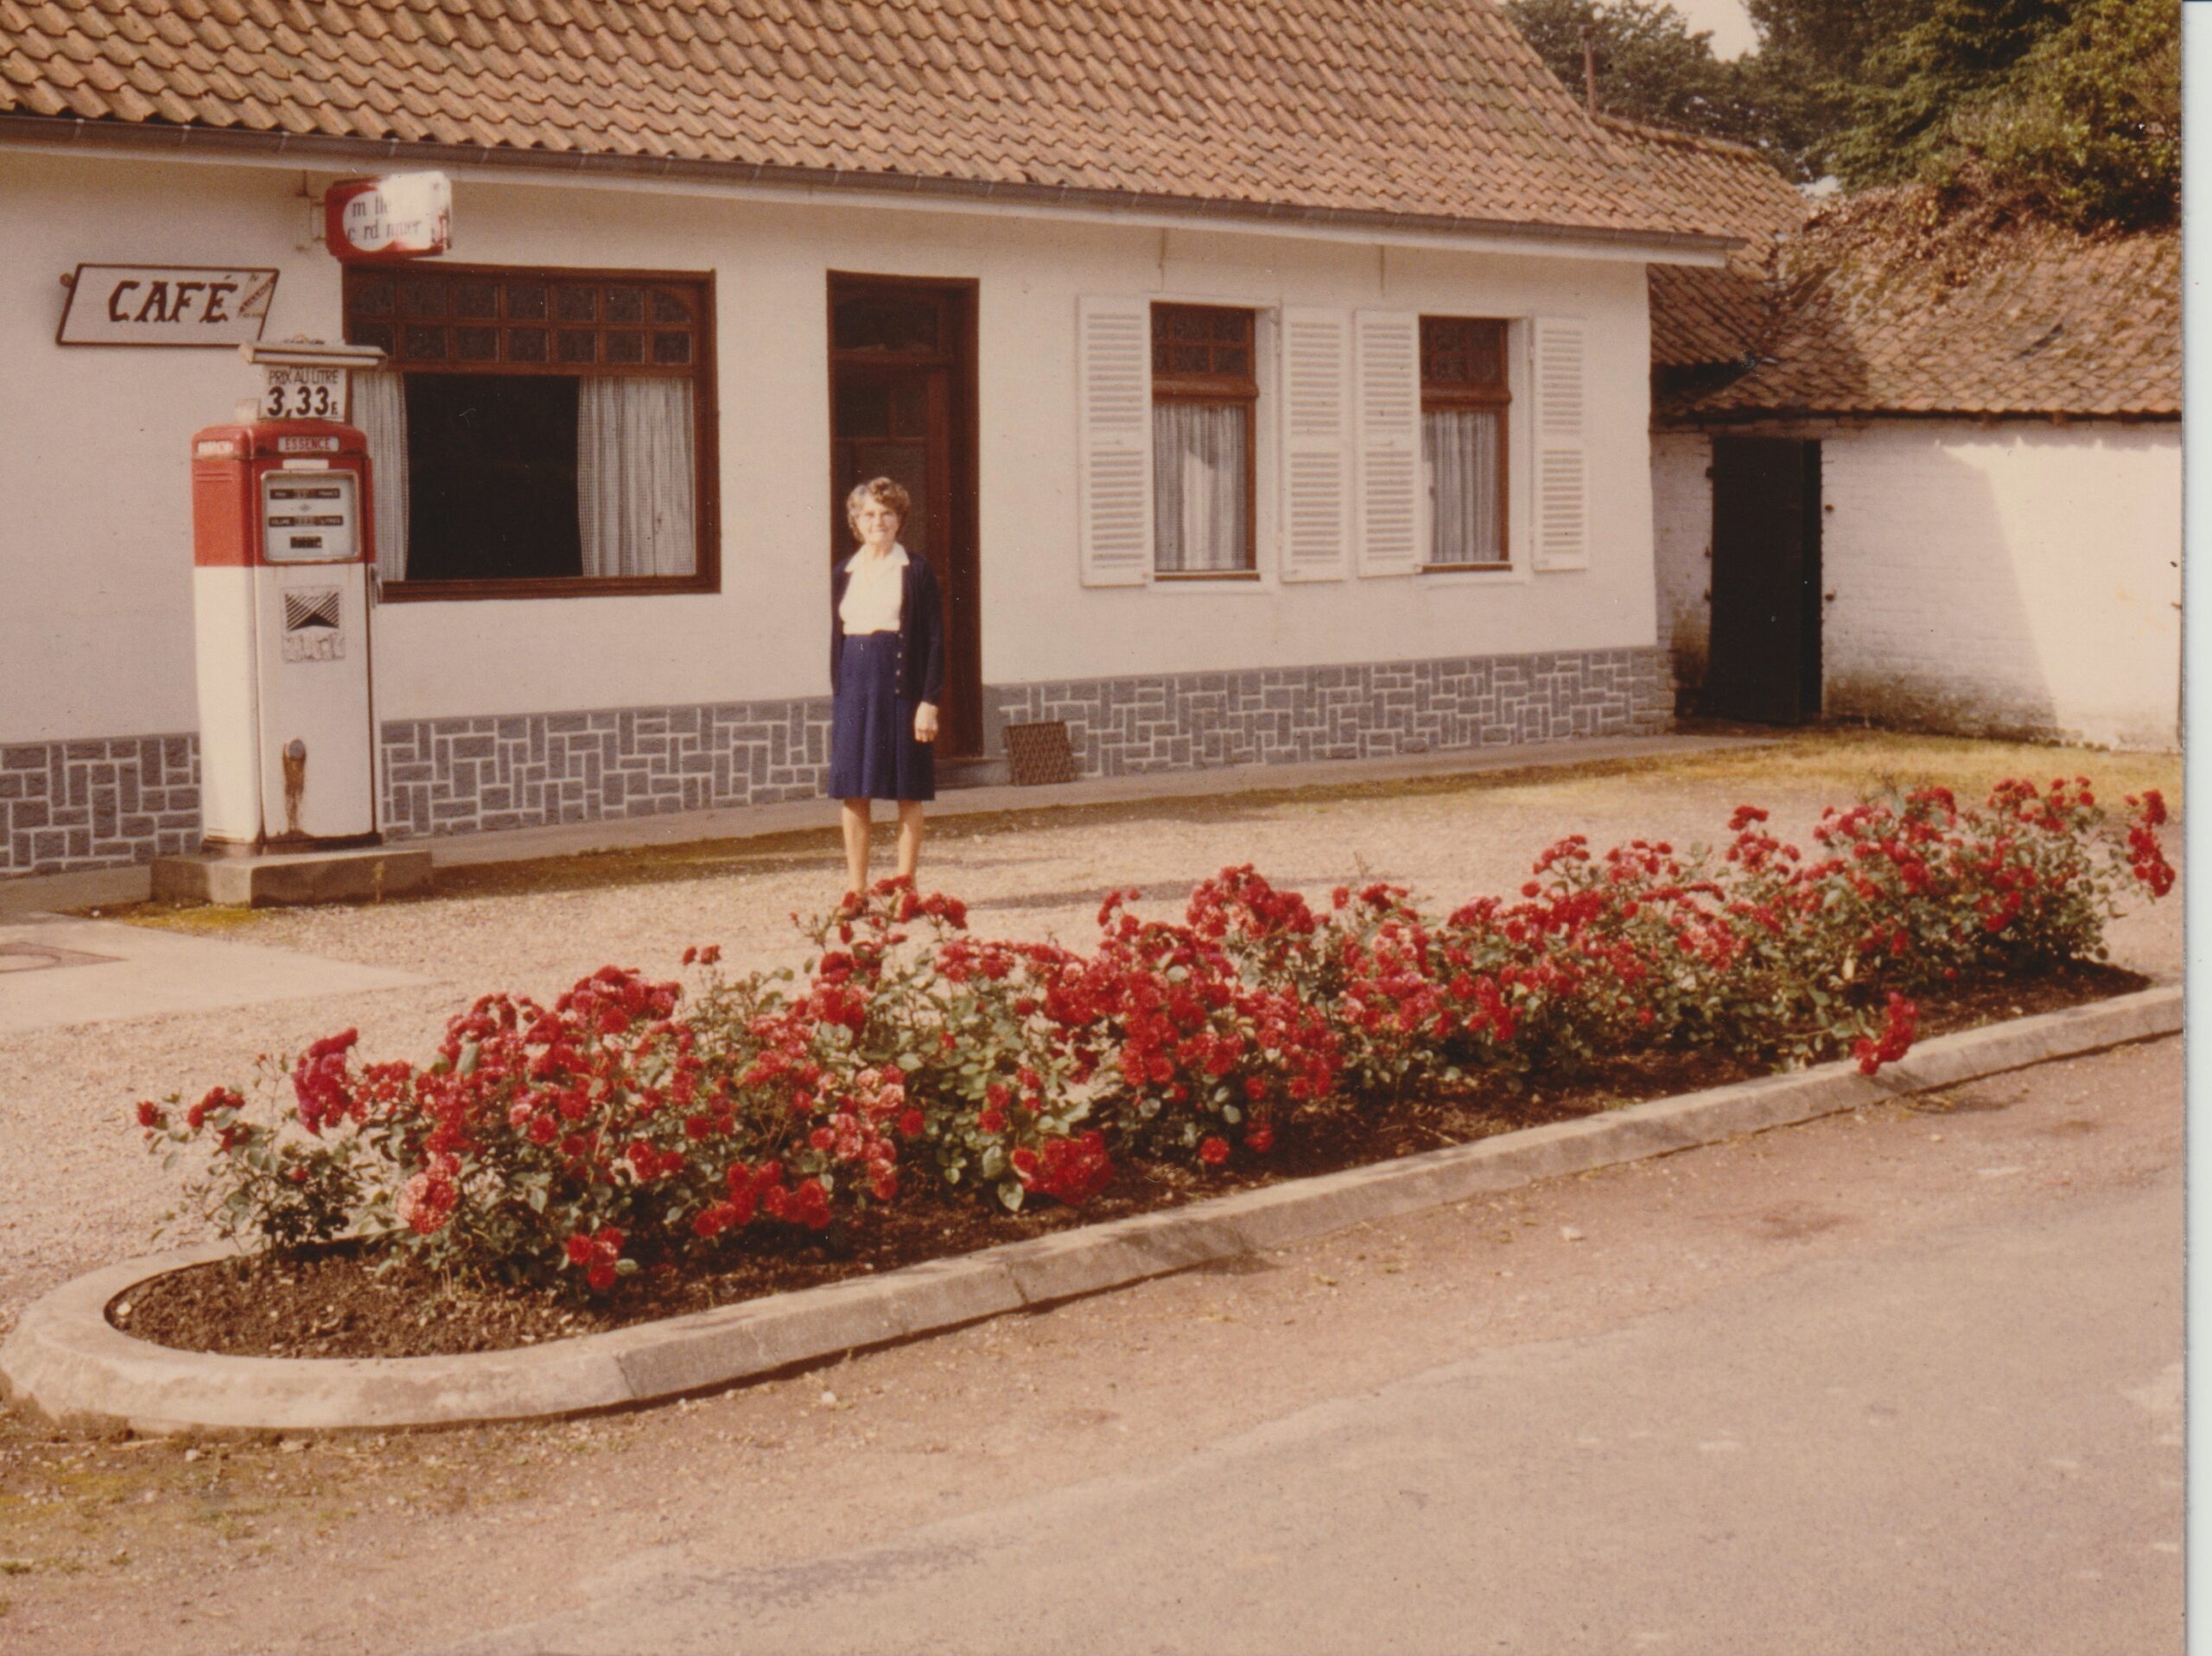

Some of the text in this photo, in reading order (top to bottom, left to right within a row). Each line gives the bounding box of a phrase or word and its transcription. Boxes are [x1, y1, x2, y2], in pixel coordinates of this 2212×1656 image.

[108, 275, 239, 323] CAFÉ
[269, 367, 339, 384] PRIX AU LITRE
[267, 387, 328, 416] 3,33
[284, 436, 331, 451] ESSENCE
